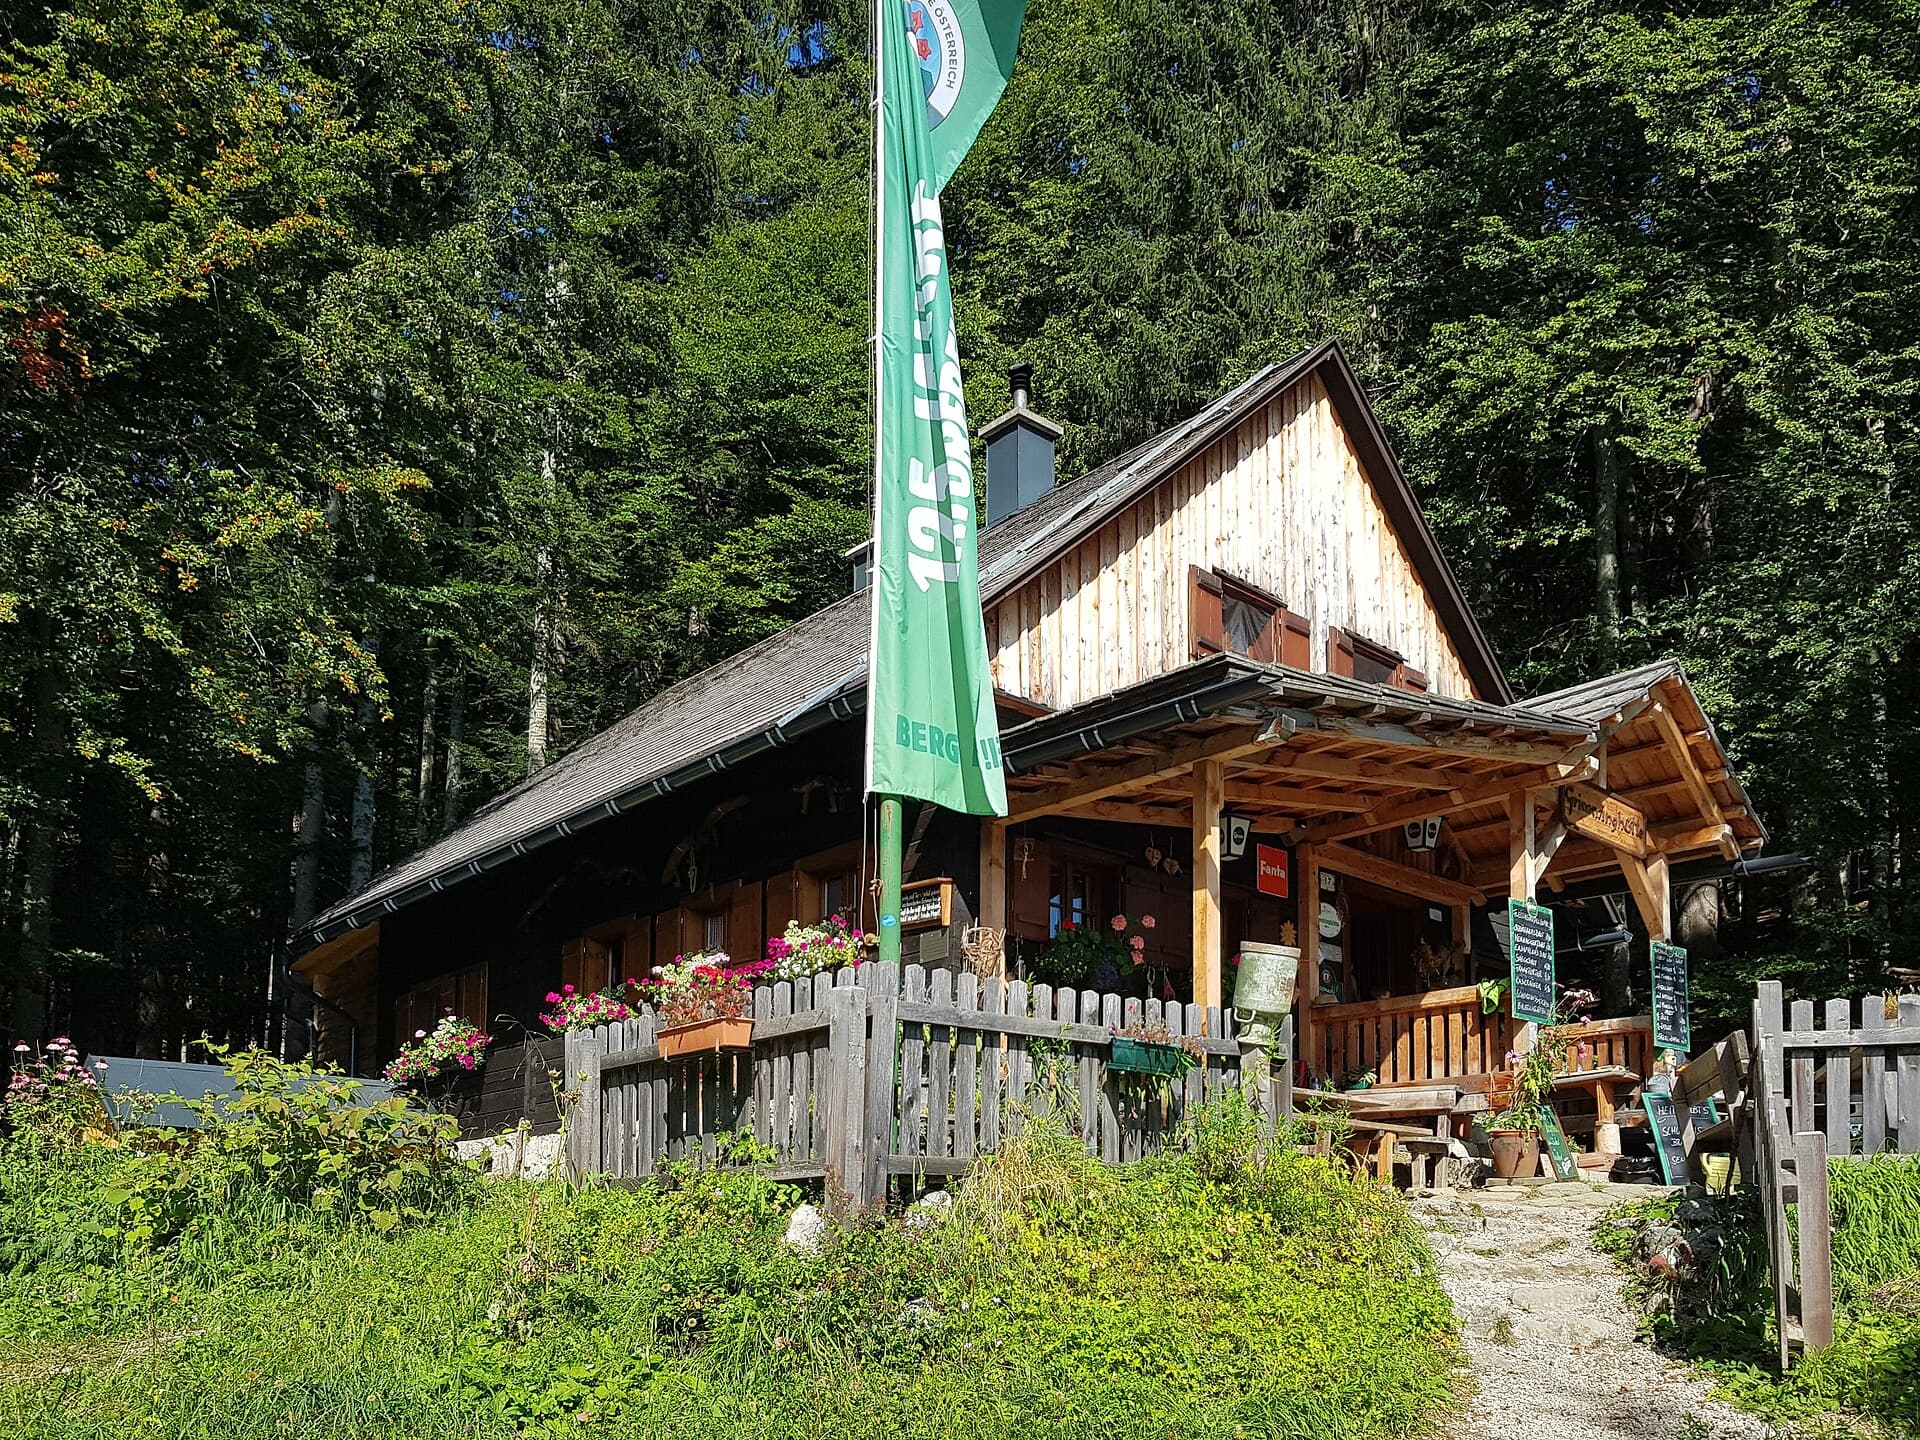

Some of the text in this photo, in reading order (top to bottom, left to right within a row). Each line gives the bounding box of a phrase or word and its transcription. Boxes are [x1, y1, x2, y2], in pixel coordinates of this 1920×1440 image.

[935, 6, 958, 90] ÖSTERREICH
[906, 456, 959, 591] 125
[896, 713, 960, 764] BERG
[1260, 860, 1286, 879] Fanta
